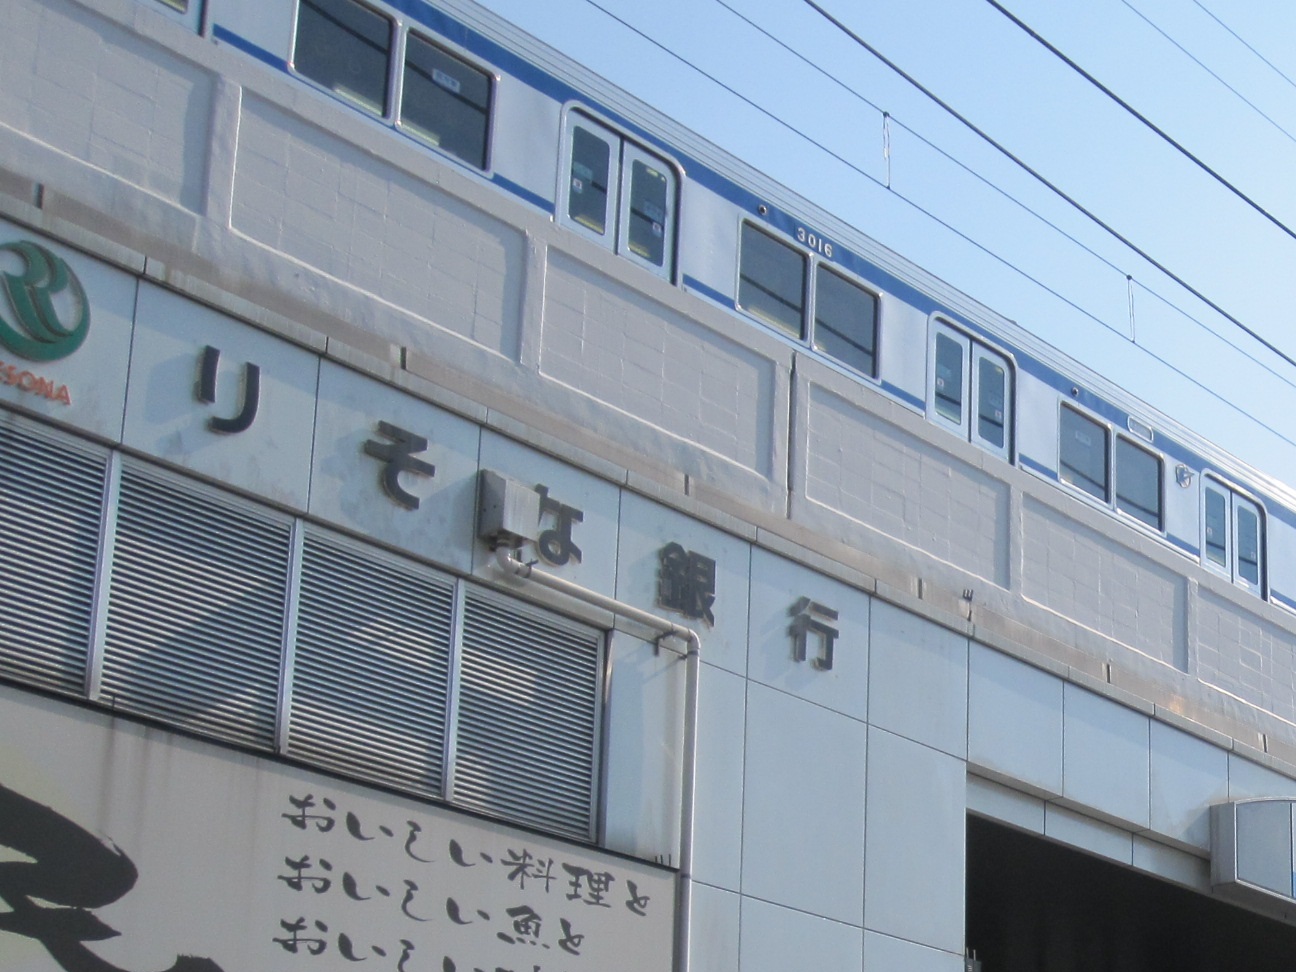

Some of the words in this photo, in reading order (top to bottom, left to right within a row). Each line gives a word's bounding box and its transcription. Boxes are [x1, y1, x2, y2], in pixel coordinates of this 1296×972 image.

[797, 226, 833, 258] 3016
[277, 854, 586, 956] おいしい魚と
[281, 793, 651, 917] おいしい料理と
